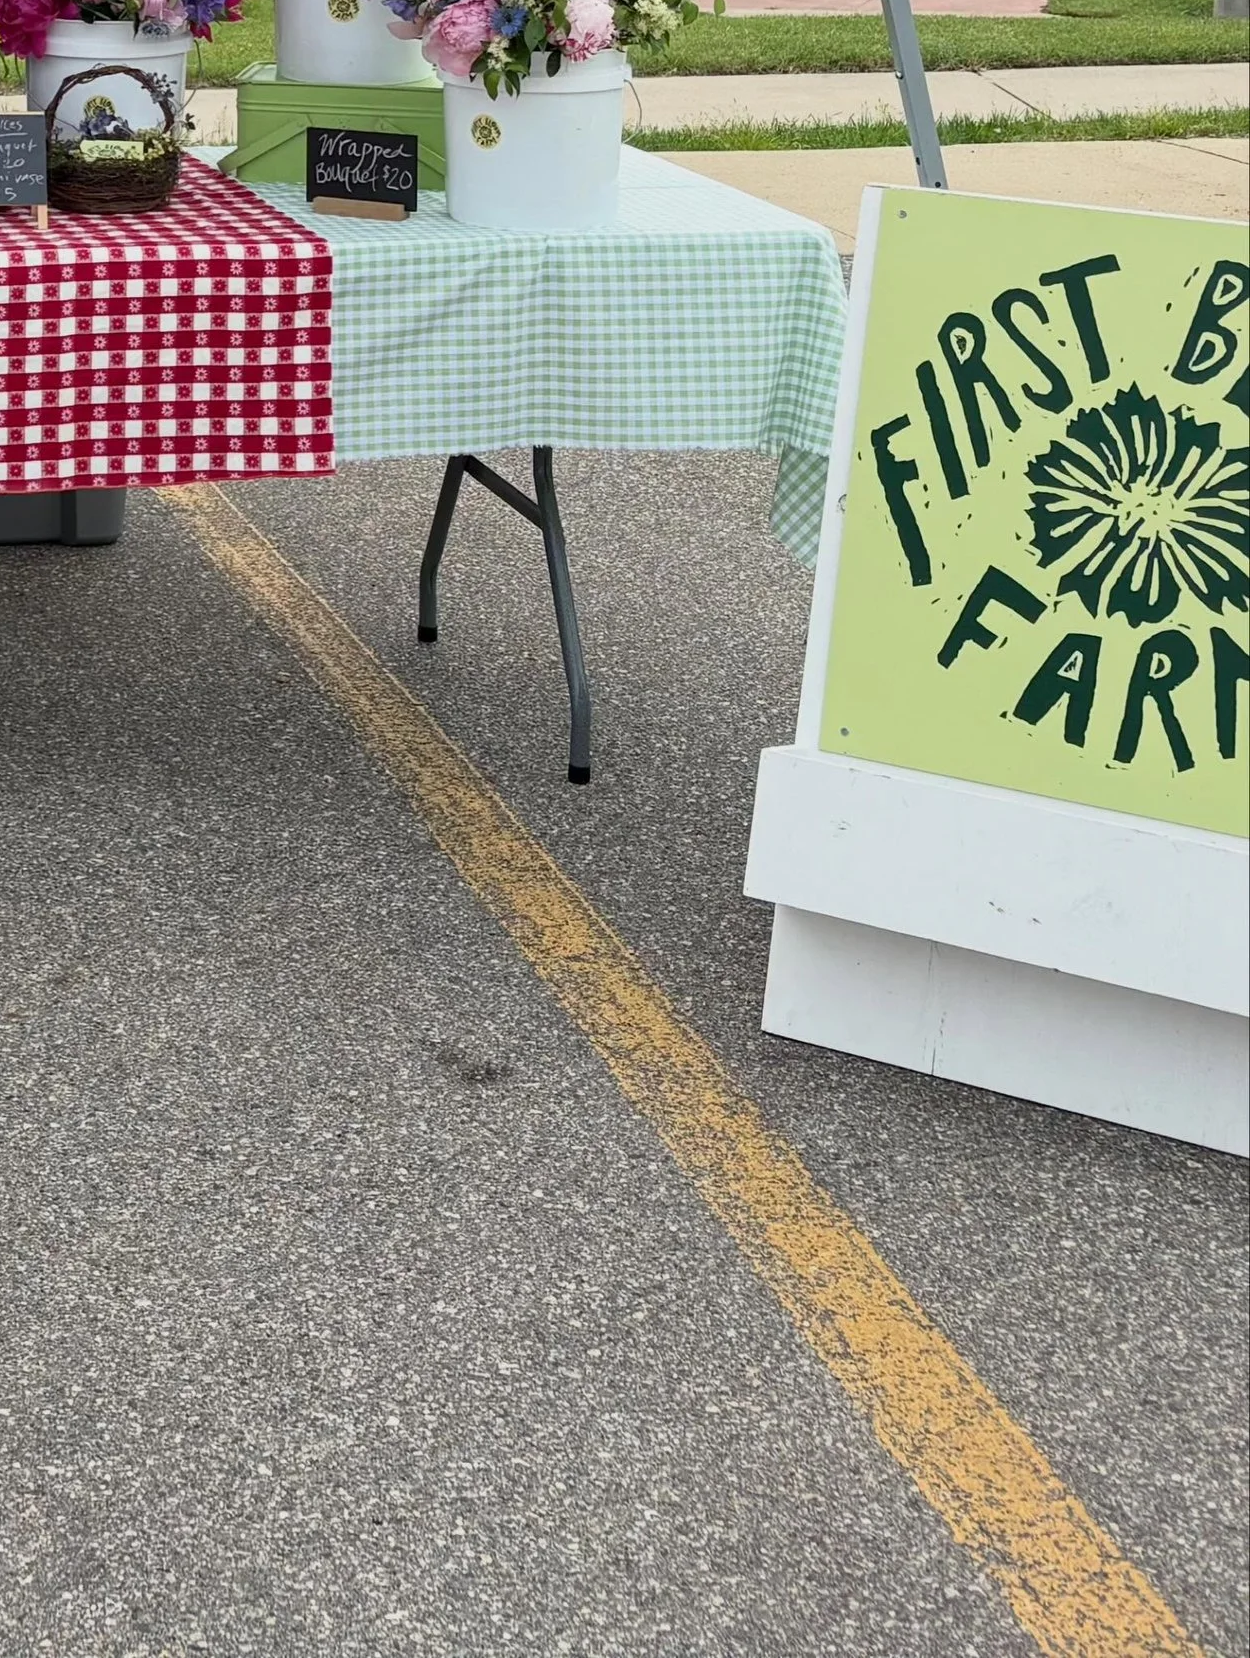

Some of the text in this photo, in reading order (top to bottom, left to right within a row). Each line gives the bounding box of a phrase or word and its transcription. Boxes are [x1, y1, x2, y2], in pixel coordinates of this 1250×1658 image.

[318, 132, 415, 174] Wrapped
[315, 161, 414, 193] Bouquet $20
[870, 253, 1122, 587] FIRST
